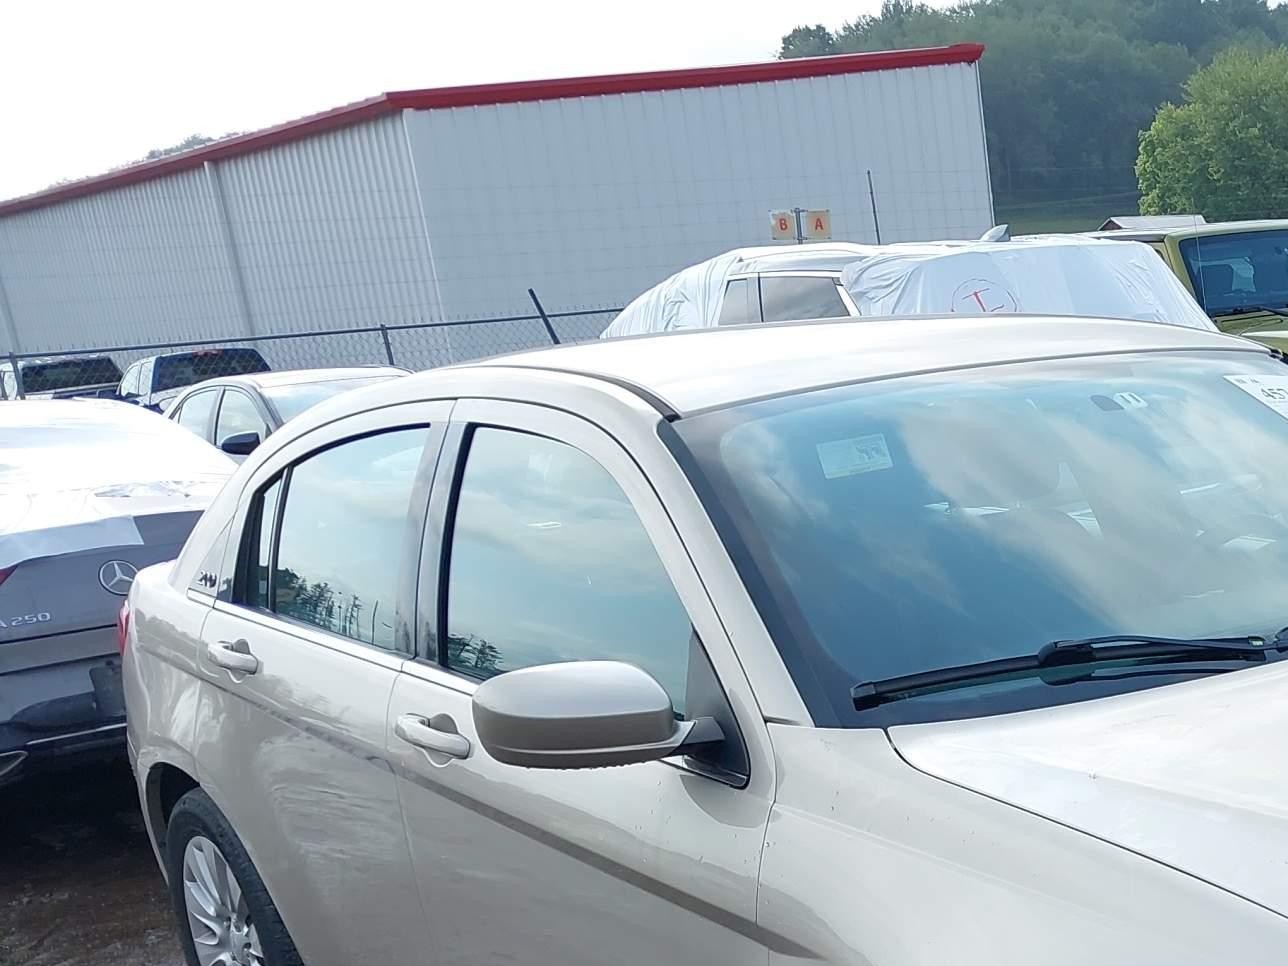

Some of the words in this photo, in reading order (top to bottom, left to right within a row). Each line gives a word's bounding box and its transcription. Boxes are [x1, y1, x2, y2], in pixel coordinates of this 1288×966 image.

[778, 218, 788, 231] B
[814, 217, 824, 231] A
[11, 612, 51, 626] 250
